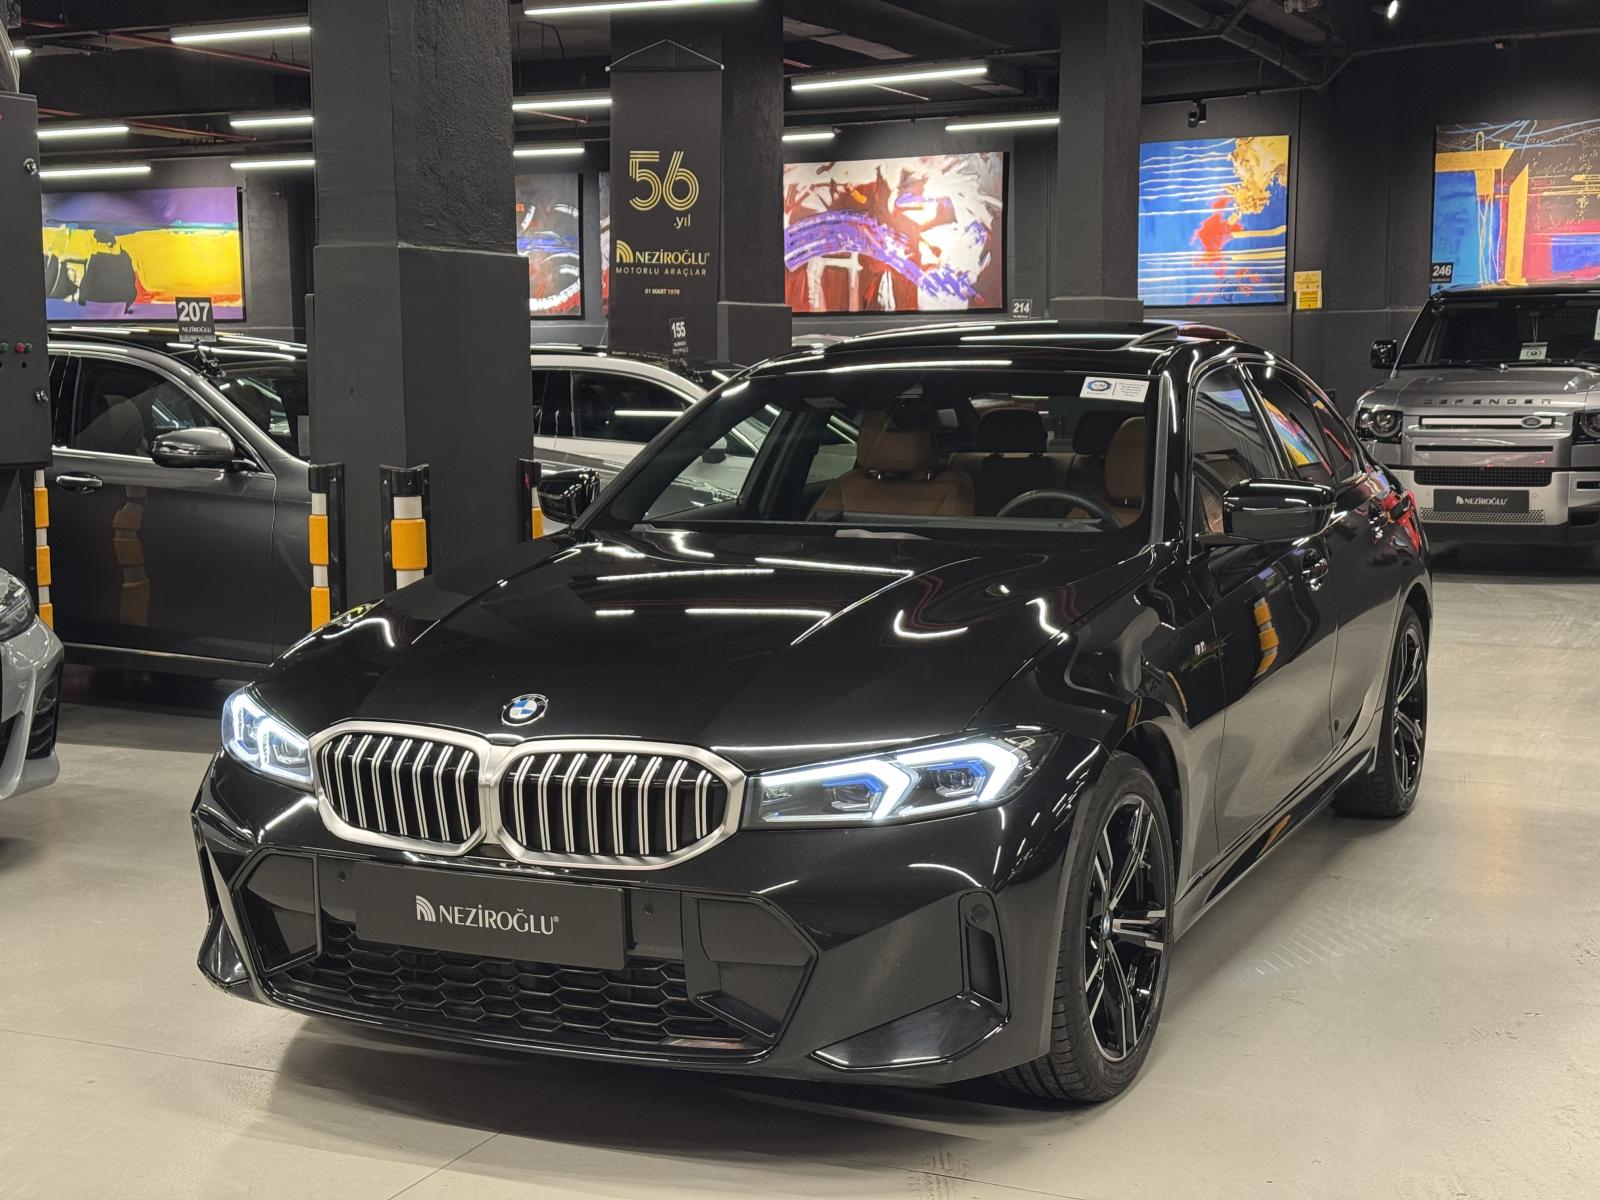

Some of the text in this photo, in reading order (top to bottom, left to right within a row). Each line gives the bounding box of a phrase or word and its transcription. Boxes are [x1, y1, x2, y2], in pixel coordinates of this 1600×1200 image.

[629, 150, 700, 211] 56
[635, 249, 708, 265] NEZİROĞLU
[615, 266, 707, 277] MOTORLU ARAÇLAR
[1432, 264, 1452, 276] 246
[178, 301, 210, 322] 207
[1012, 302, 1030, 314] 214
[671, 321, 686, 339] 155
[439, 904, 554, 935] NEZİROĞLU
